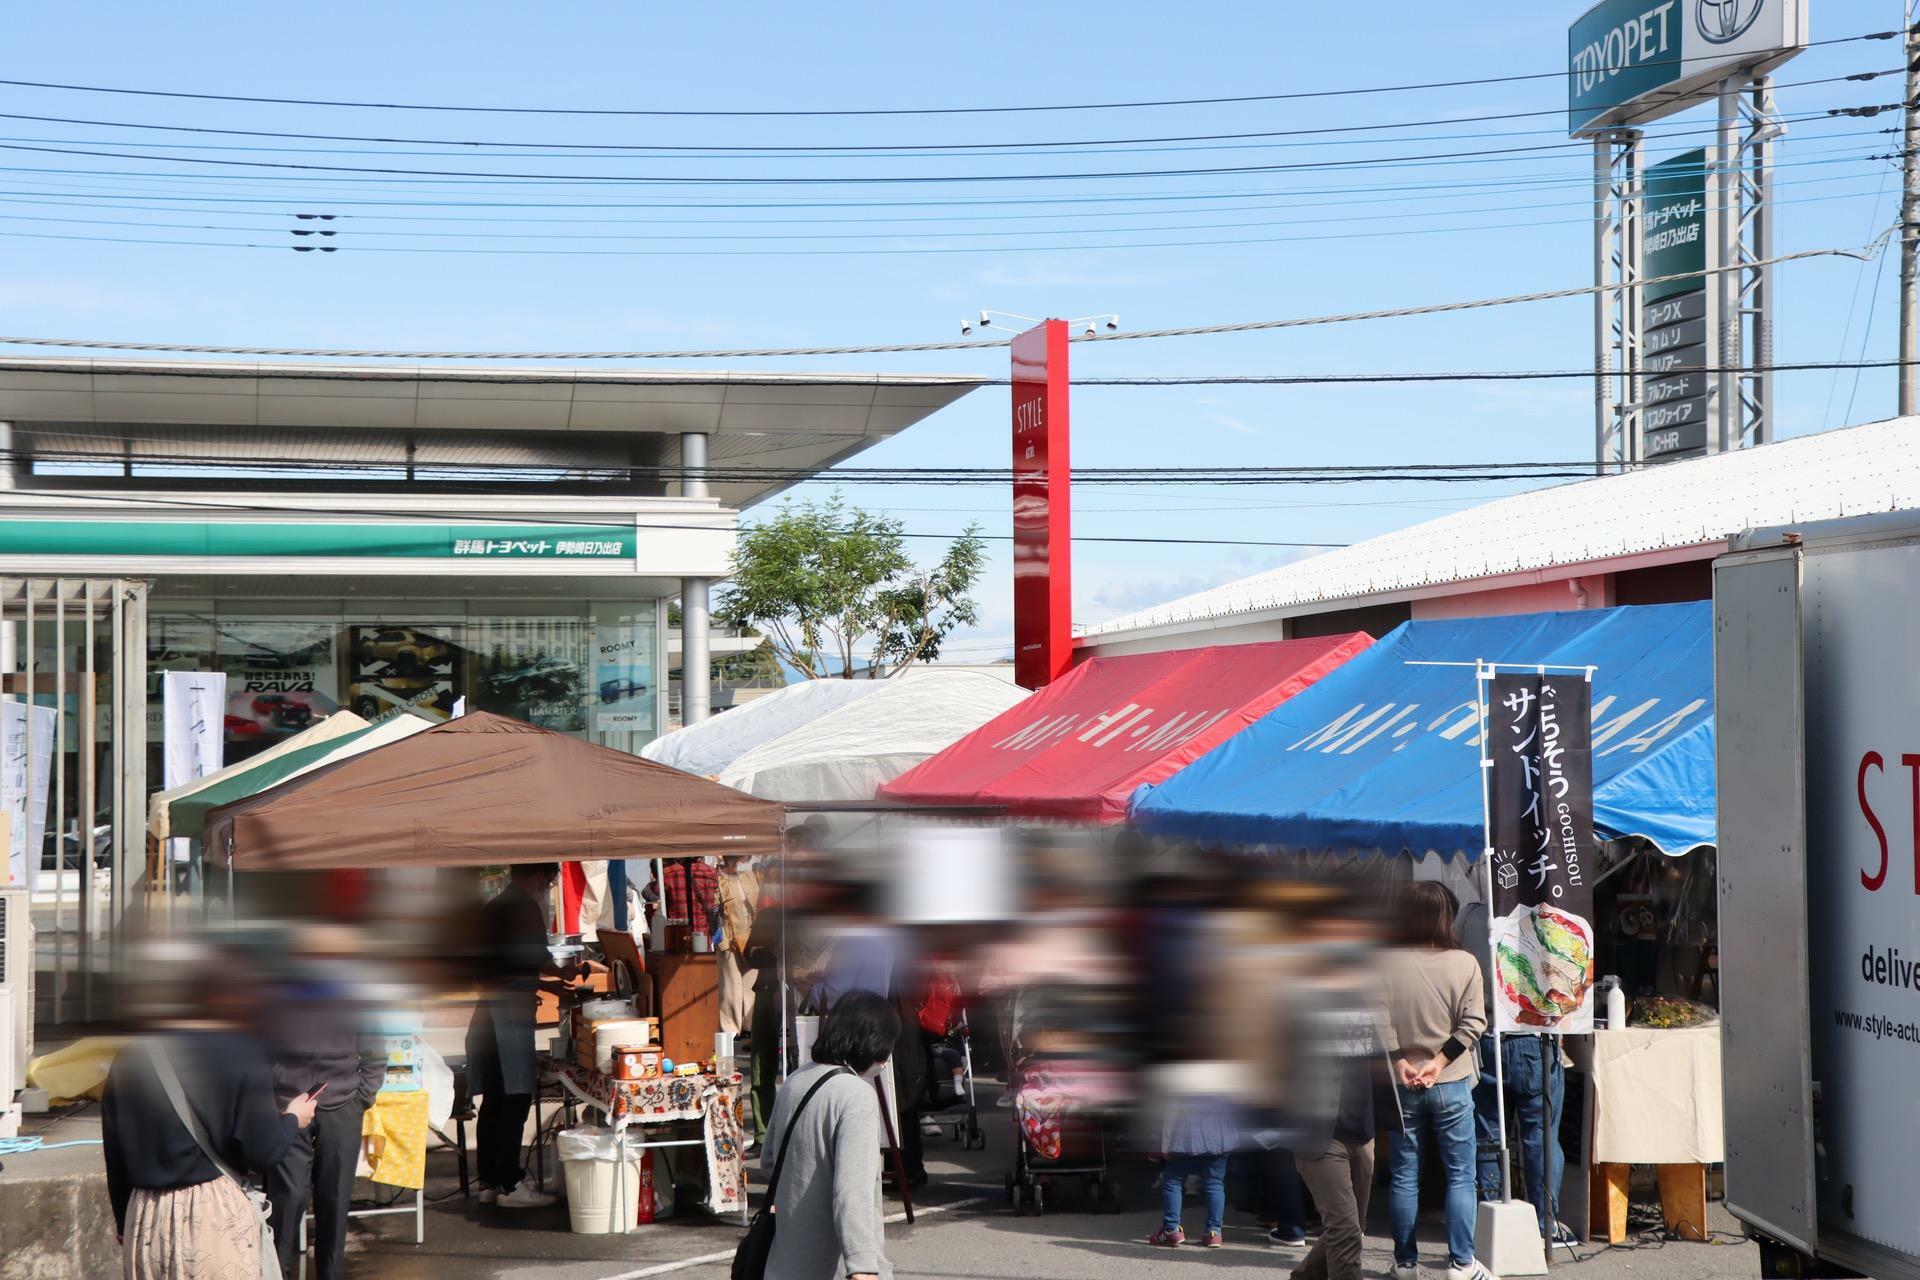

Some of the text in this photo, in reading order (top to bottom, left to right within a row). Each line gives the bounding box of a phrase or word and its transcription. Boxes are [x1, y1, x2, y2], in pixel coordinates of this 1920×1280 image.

[1573, 0, 1674, 97] TOYOPET
[1650, 301, 1682, 324] マークX
[1652, 328, 1681, 349] カムリ
[1018, 397, 1042, 433] STYLE
[1654, 432, 1680, 451] C-HR
[454, 540, 623, 555] 群馬トヨペット 伊勢崎日乃出店
[601, 640, 635, 654] ROOMY
[244, 681, 315, 693] RAV4
[406, 686, 439, 707] CROSS
[1541, 685, 1583, 887] ごちそう GOCHISOU
